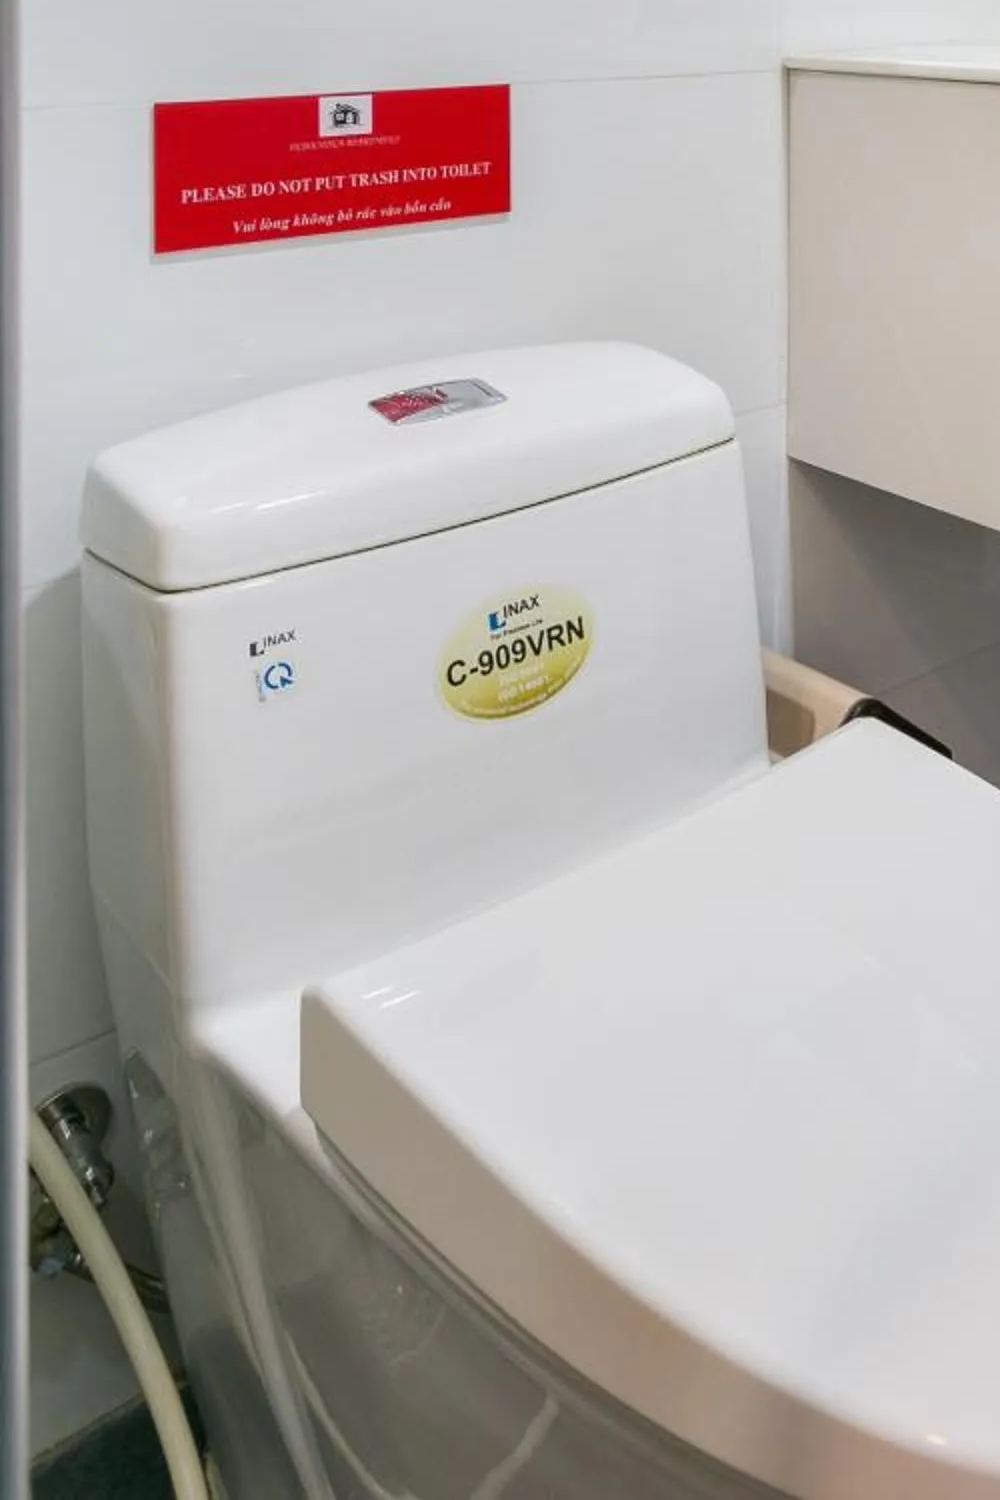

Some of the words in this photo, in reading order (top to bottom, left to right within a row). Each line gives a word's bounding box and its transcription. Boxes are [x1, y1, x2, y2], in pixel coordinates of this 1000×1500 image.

[181, 183, 247, 204] PLEASE
[251, 181, 275, 197] DO
[279, 177, 312, 194] NOT
[315, 175, 346, 191] PUT
[350, 169, 399, 187] TRASH
[402, 165, 437, 182] INTO
[439, 161, 492, 178] TOILET
[503, 594, 541, 619] INAX
[263, 630, 296, 648] INAX
[446, 615, 586, 687] C-909VRN
